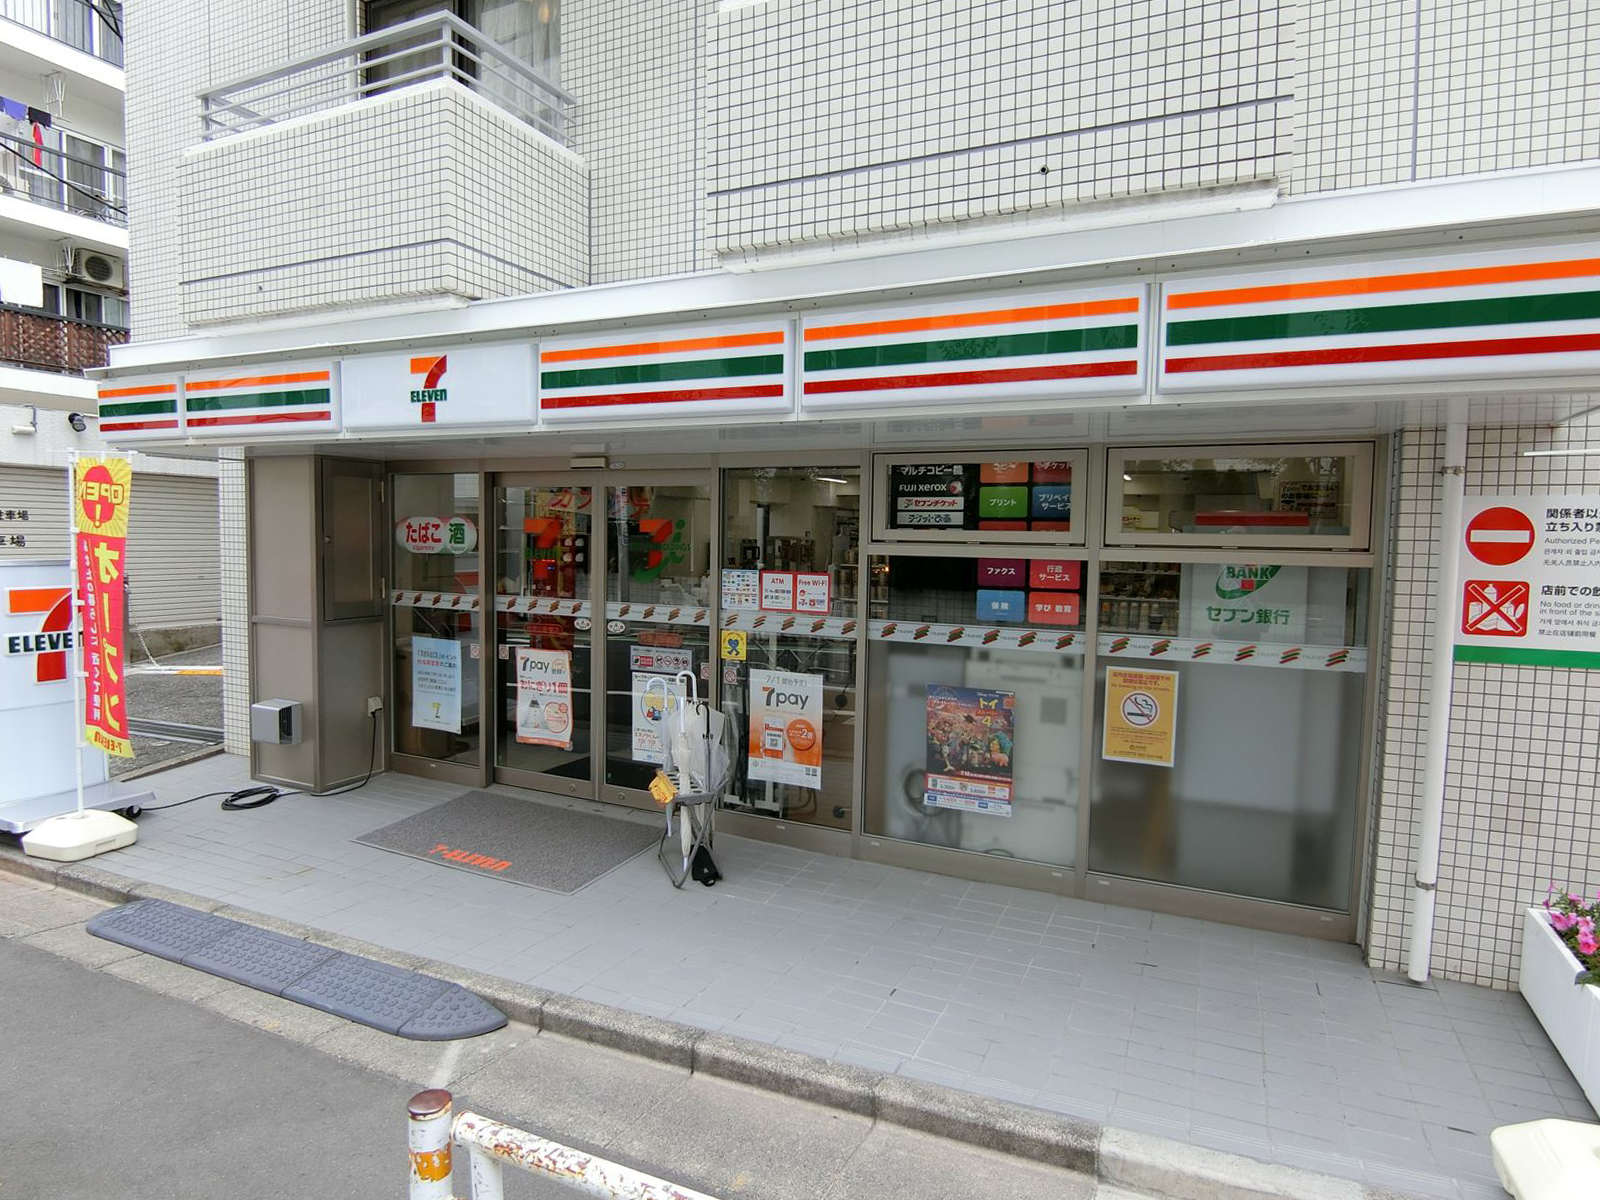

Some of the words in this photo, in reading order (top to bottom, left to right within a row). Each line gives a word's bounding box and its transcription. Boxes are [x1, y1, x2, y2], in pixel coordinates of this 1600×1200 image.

[410, 355, 447, 422] 7
[900, 465, 963, 476] マルチコピー機
[899, 484, 917, 492] FUJI
[918, 483, 947, 492] xerox
[914, 499, 958, 507] セブンチケット
[989, 498, 1017, 507] プリント
[1545, 508, 1600, 519] 関係者以
[405, 522, 442, 544] たばこ
[449, 522, 465, 545] 酒
[1544, 537, 1587, 545] Authorized
[986, 567, 1016, 575] ファクス
[1046, 564, 1063, 573] 行政
[1226, 566, 1270, 580] BANK
[770, 577, 785, 585] ATM
[1038, 573, 1070, 582] サービス
[798, 579, 811, 587] Free
[991, 601, 1009, 611] 保険
[1035, 603, 1051, 612] 学び
[1055, 604, 1071, 613] 教育
[1206, 605, 1291, 625] セブン銀行
[520, 656, 550, 674] 7pay
[520, 679, 568, 695] おにぎり1個
[762, 686, 809, 710] 7pay
